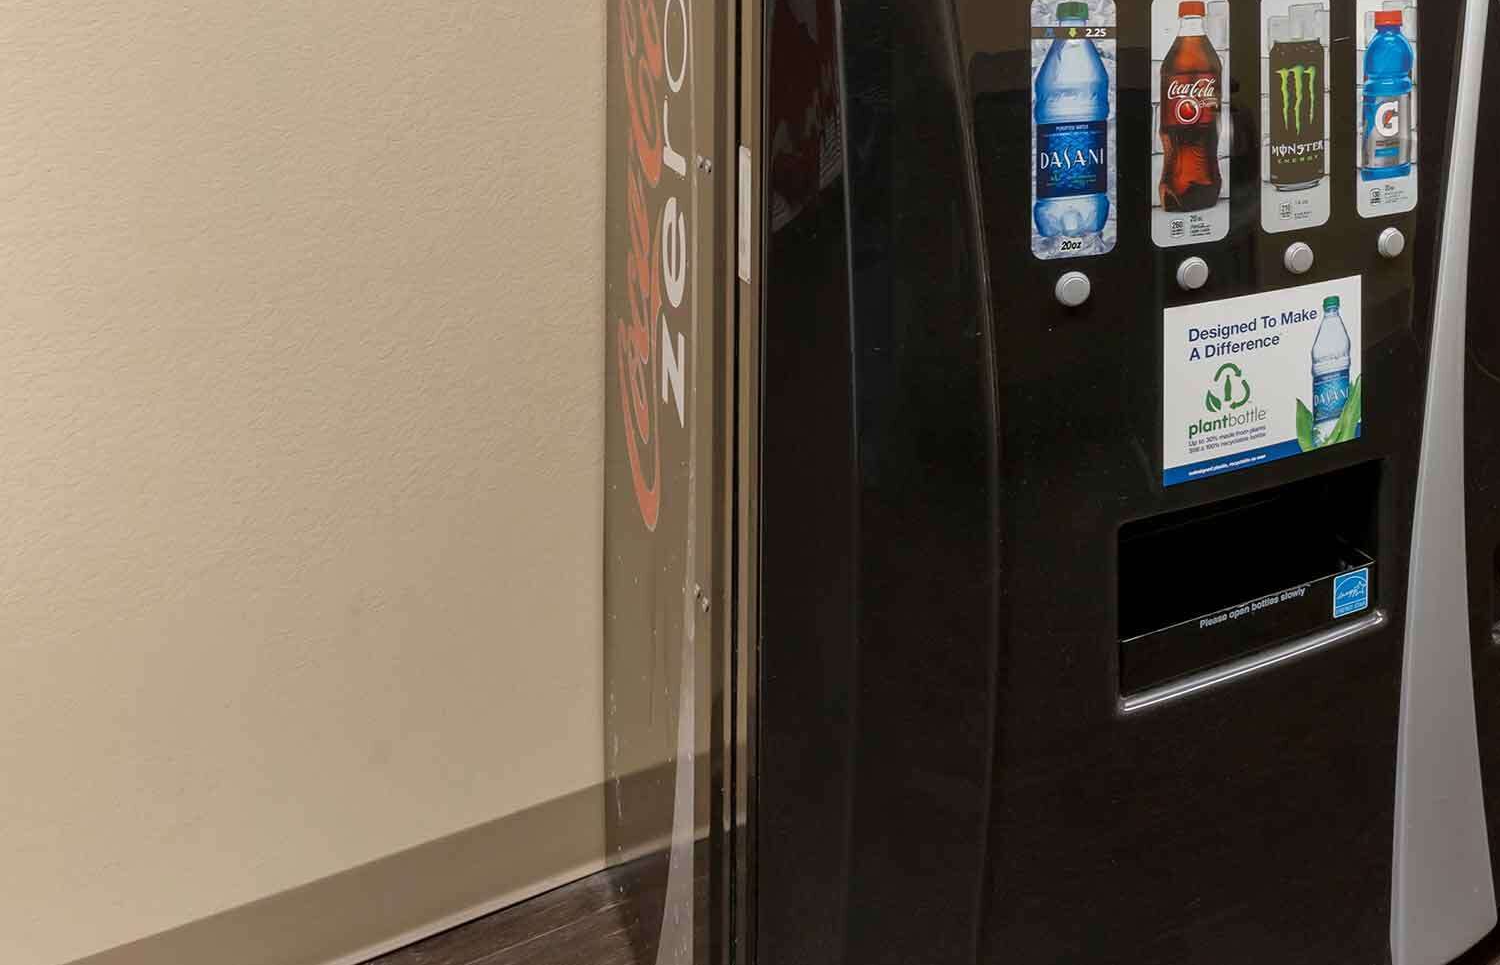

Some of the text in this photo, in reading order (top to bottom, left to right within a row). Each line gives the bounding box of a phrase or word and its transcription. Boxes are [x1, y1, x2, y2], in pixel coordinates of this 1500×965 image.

[1085, 28, 1106, 38] 2.25
[1167, 78, 1216, 100] Coca-Cola
[1375, 101, 1399, 137] G
[1040, 147, 1104, 170] DASANI
[1271, 140, 1324, 157] MONSTER
[1061, 239, 1082, 253] 20oz
[1188, 307, 1318, 343] Designed To Make
[1189, 334, 1281, 362] A Difference
[1188, 407, 1266, 439] plantbottle
